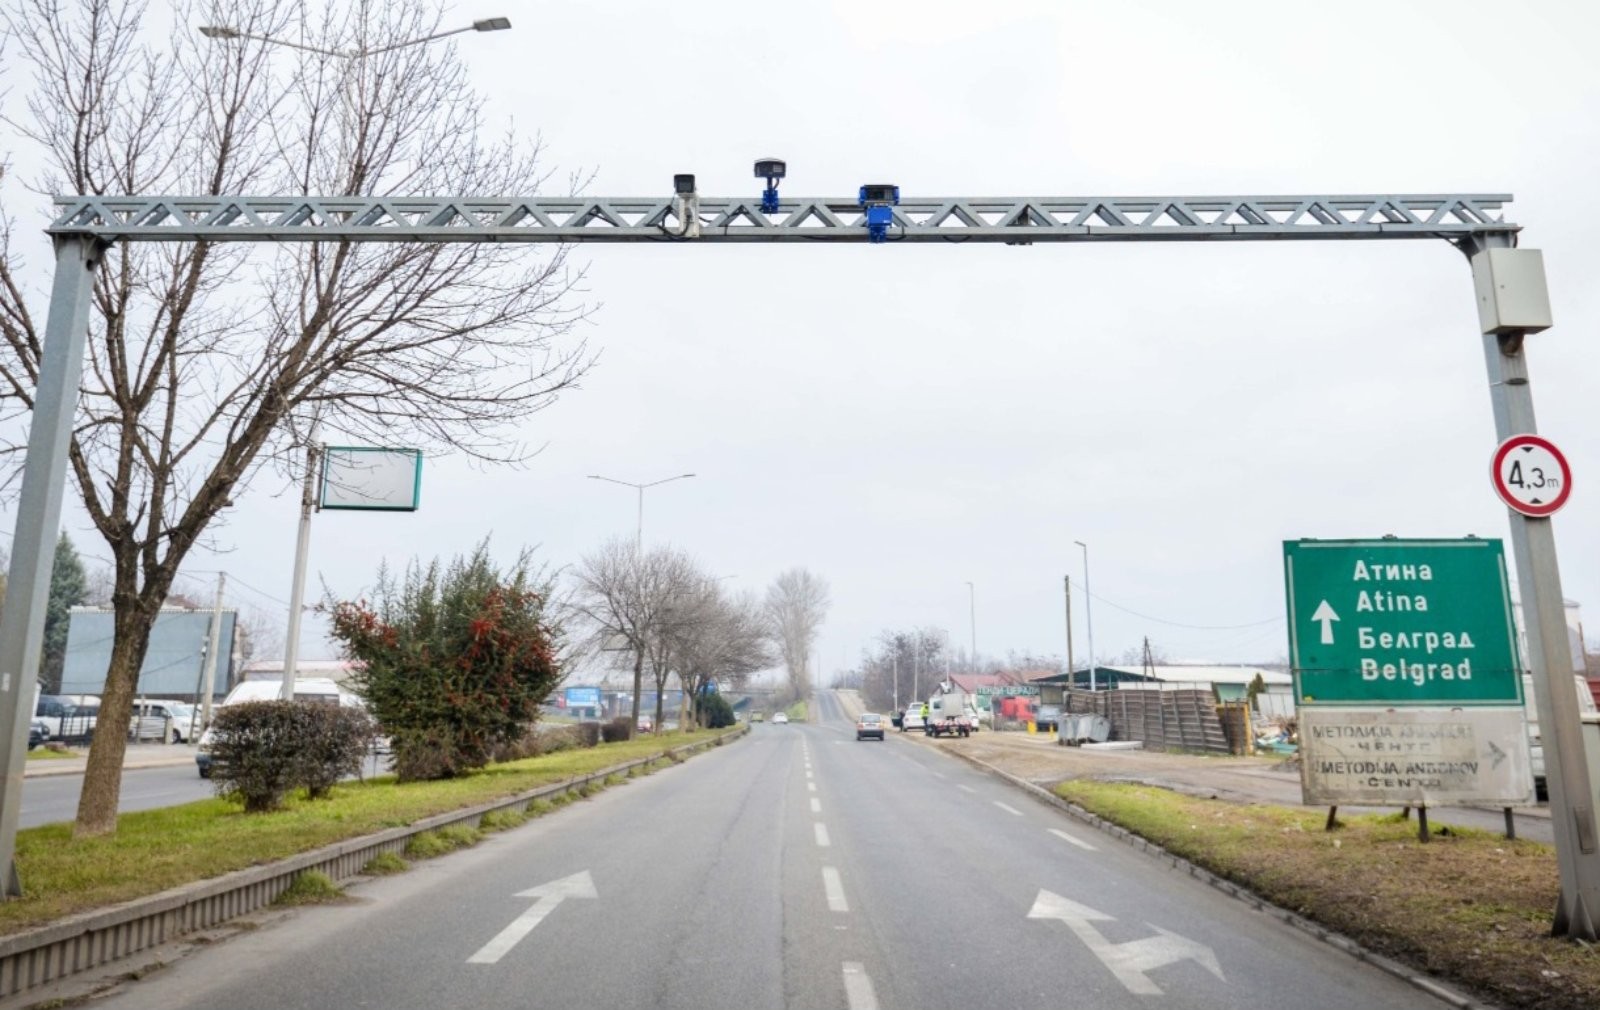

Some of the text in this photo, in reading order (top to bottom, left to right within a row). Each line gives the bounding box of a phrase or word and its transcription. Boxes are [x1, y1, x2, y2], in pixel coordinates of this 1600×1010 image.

[1353, 559, 1433, 582] Атина
[1356, 590, 1428, 612] Atina
[1358, 627, 1475, 654] Белград
[1361, 658, 1473, 686] Belgrad
[1321, 761, 1399, 775] METODIJA
